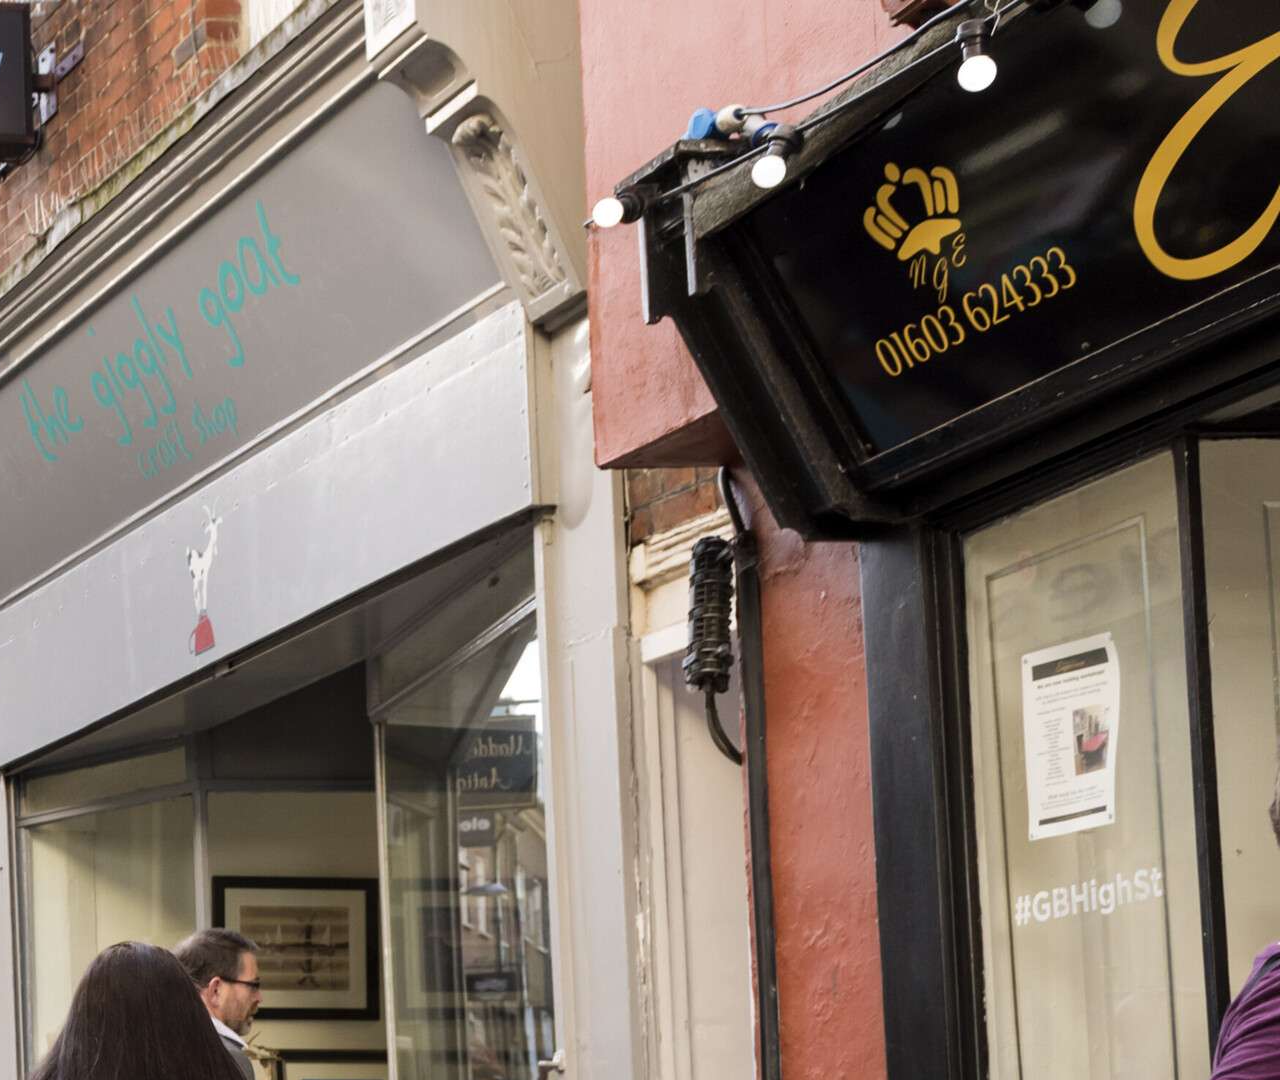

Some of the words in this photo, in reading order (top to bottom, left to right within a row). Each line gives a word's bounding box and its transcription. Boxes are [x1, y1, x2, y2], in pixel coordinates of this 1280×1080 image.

[18, 376, 83, 462] the
[88, 292, 193, 446] giggly
[198, 198, 301, 368] goat
[875, 305, 965, 377] 01603
[963, 246, 1077, 332] 624333
[191, 396, 239, 446] shop
[1014, 867, 1163, 926] #GBHighSt
